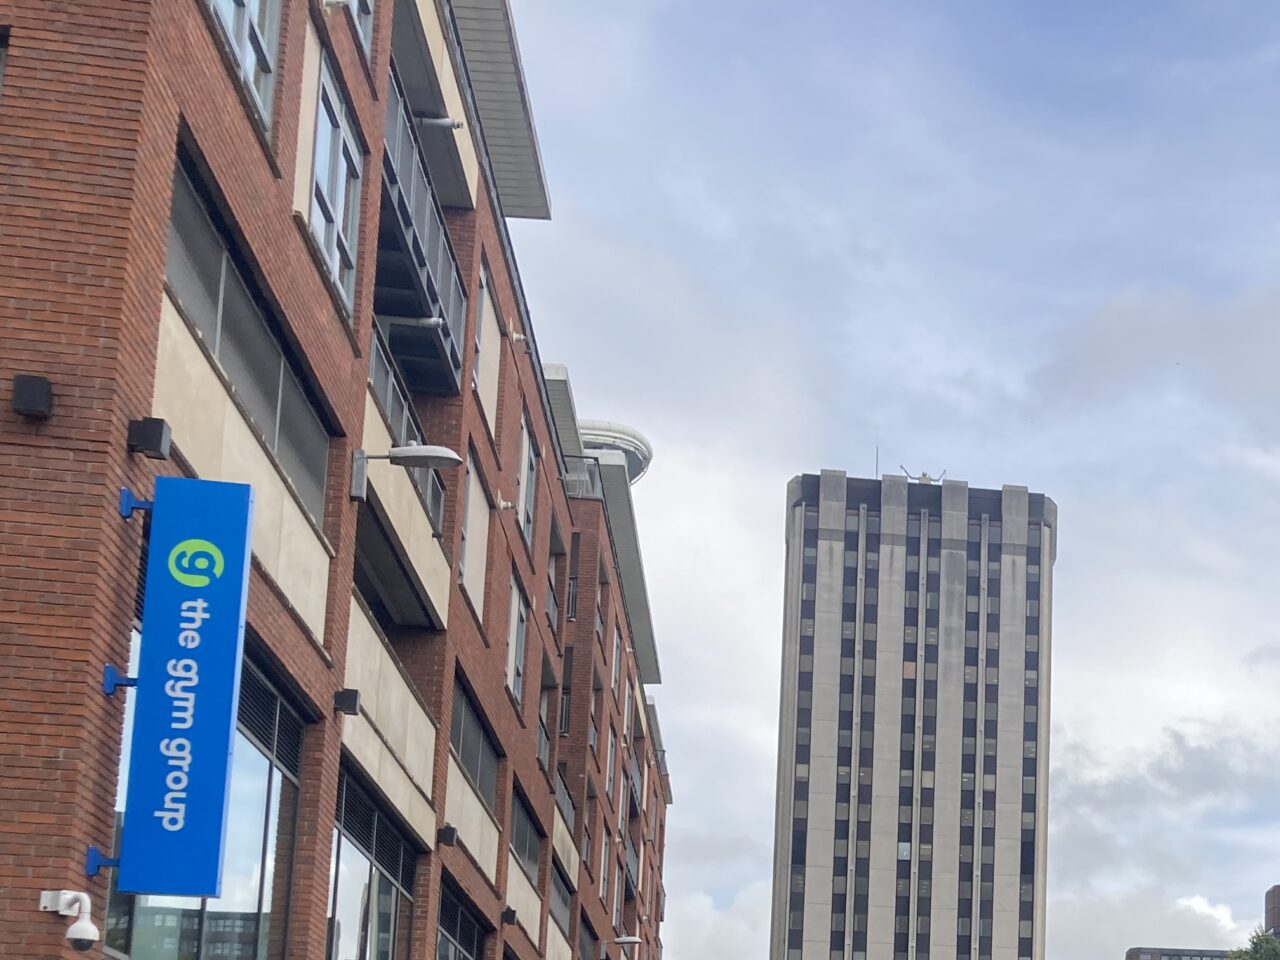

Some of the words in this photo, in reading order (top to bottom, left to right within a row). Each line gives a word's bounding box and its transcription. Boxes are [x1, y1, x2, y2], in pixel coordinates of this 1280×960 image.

[178, 598, 210, 649] the
[164, 658, 200, 730] gym
[153, 737, 192, 832] group
